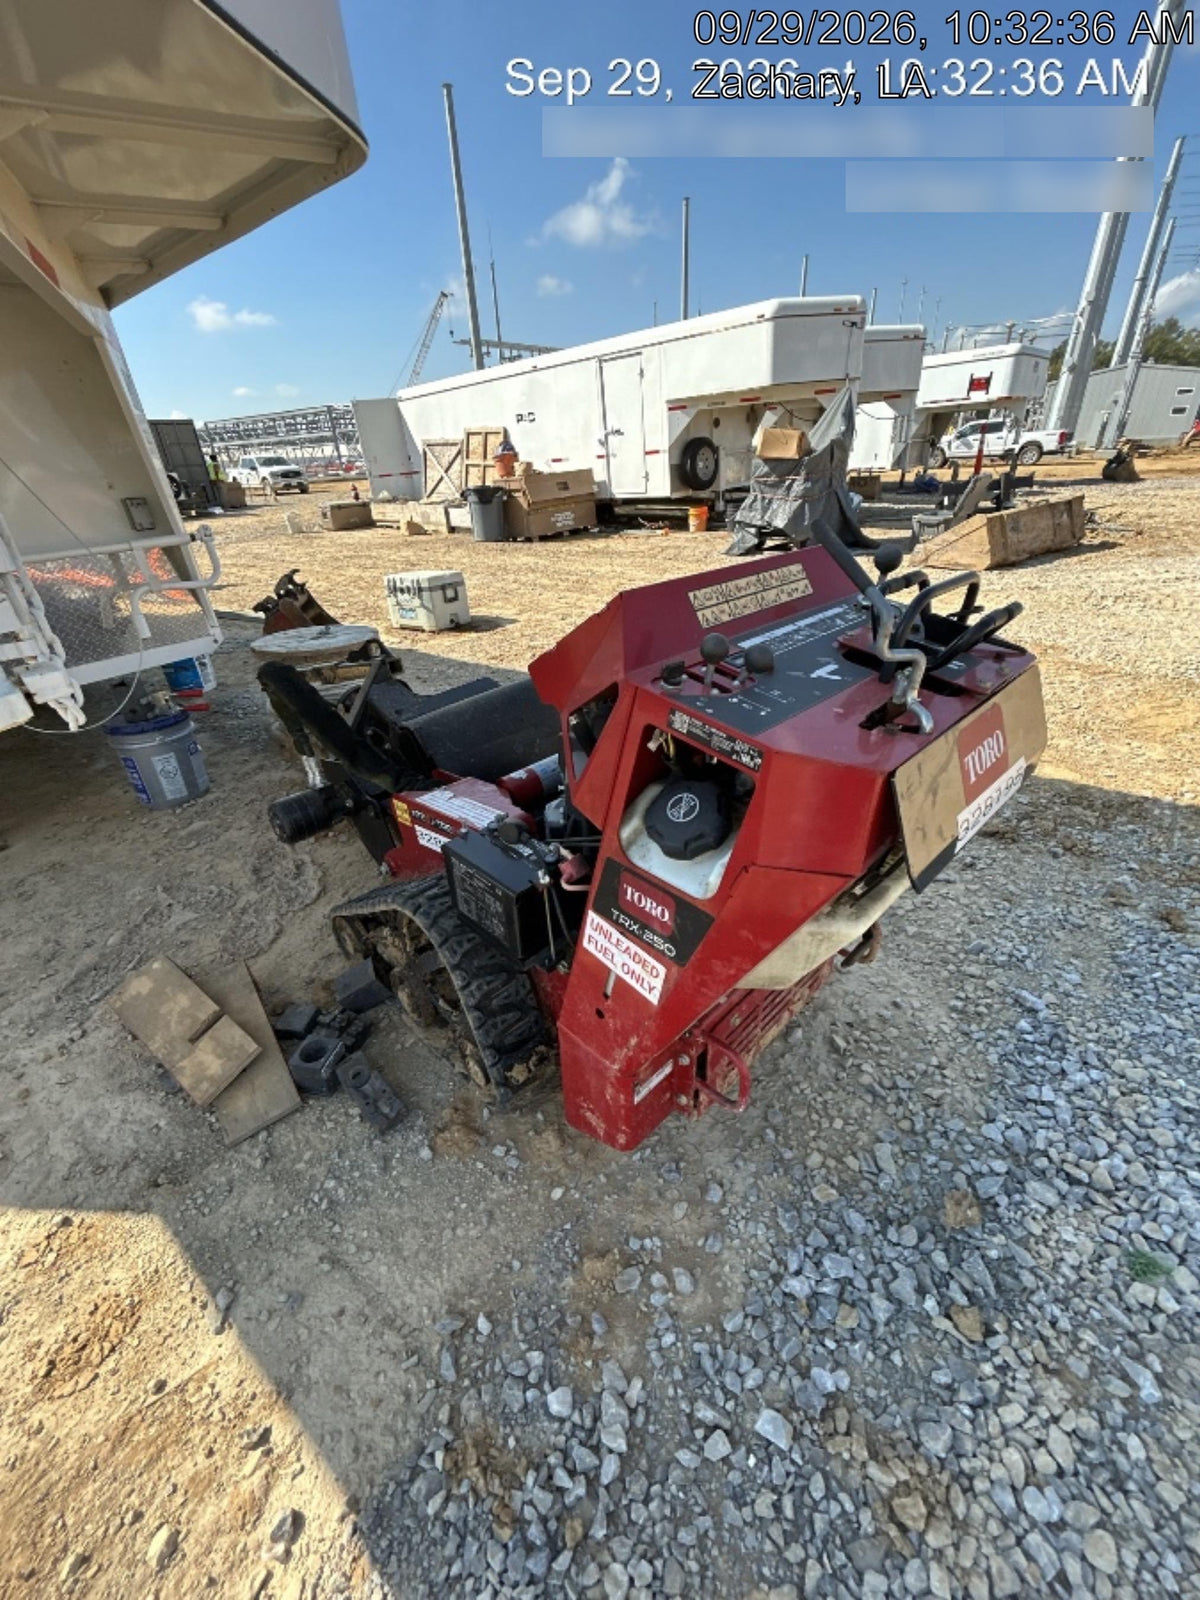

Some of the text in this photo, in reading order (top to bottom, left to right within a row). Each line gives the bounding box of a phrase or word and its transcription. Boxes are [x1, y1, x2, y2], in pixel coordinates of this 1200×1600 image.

[963, 729, 1005, 785] TORO
[622, 883, 671, 923] TORO
[587, 934, 657, 995] FUEL ONLY
[590, 918, 660, 979] UNLEADED
